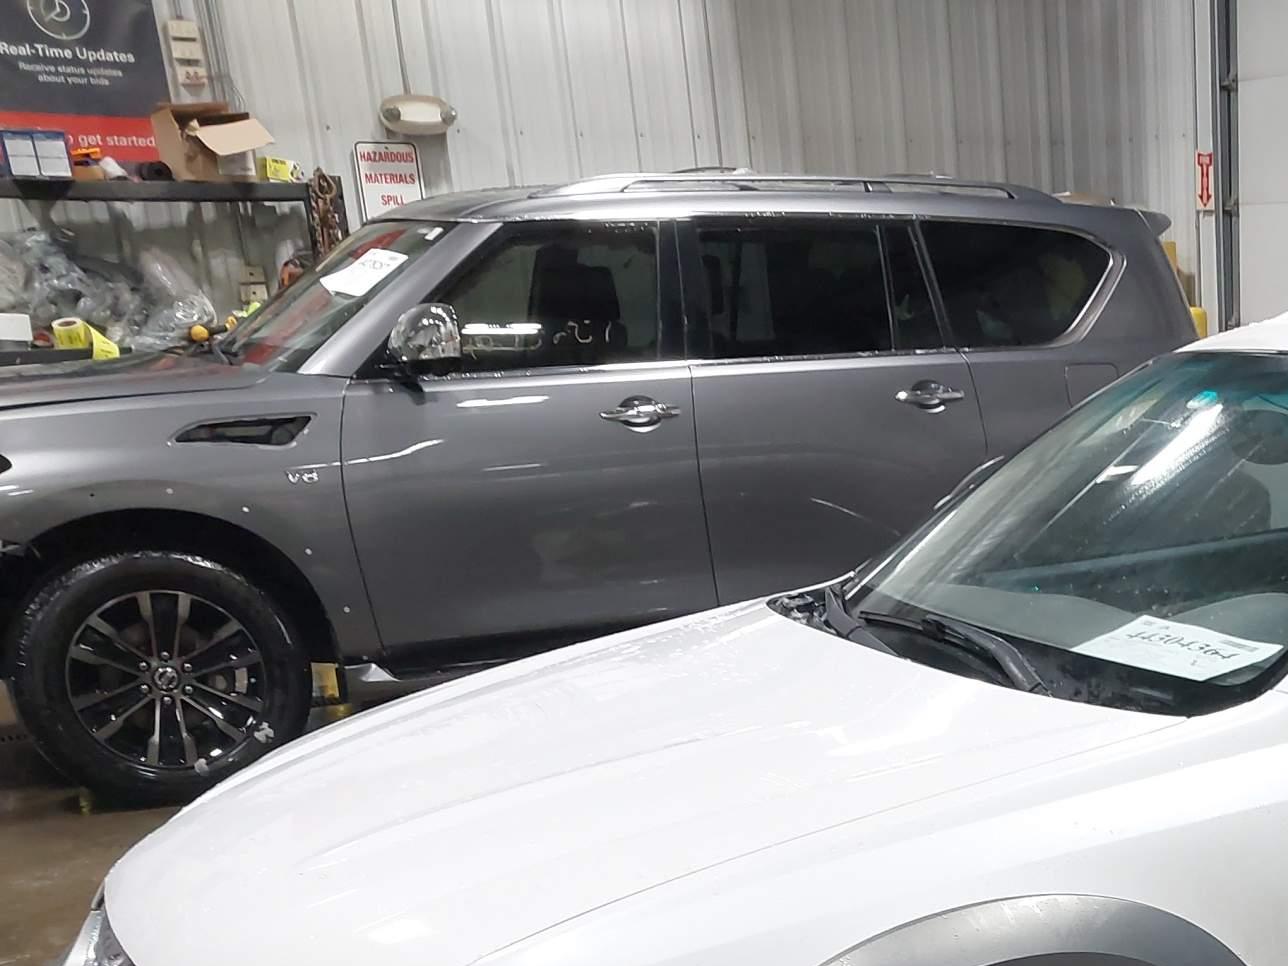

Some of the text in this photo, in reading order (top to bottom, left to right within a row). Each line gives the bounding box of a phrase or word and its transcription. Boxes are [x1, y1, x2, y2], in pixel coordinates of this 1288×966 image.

[0, 41, 136, 63] Real-Time Updates
[57, 65, 86, 74] status
[38, 73, 66, 83] about
[66, 76, 88, 86] your
[78, 134, 103, 147] get
[106, 135, 156, 147] started
[360, 151, 415, 163] HAZARDOUS
[365, 173, 416, 184] MATERIALS
[381, 194, 406, 206] SPILL
